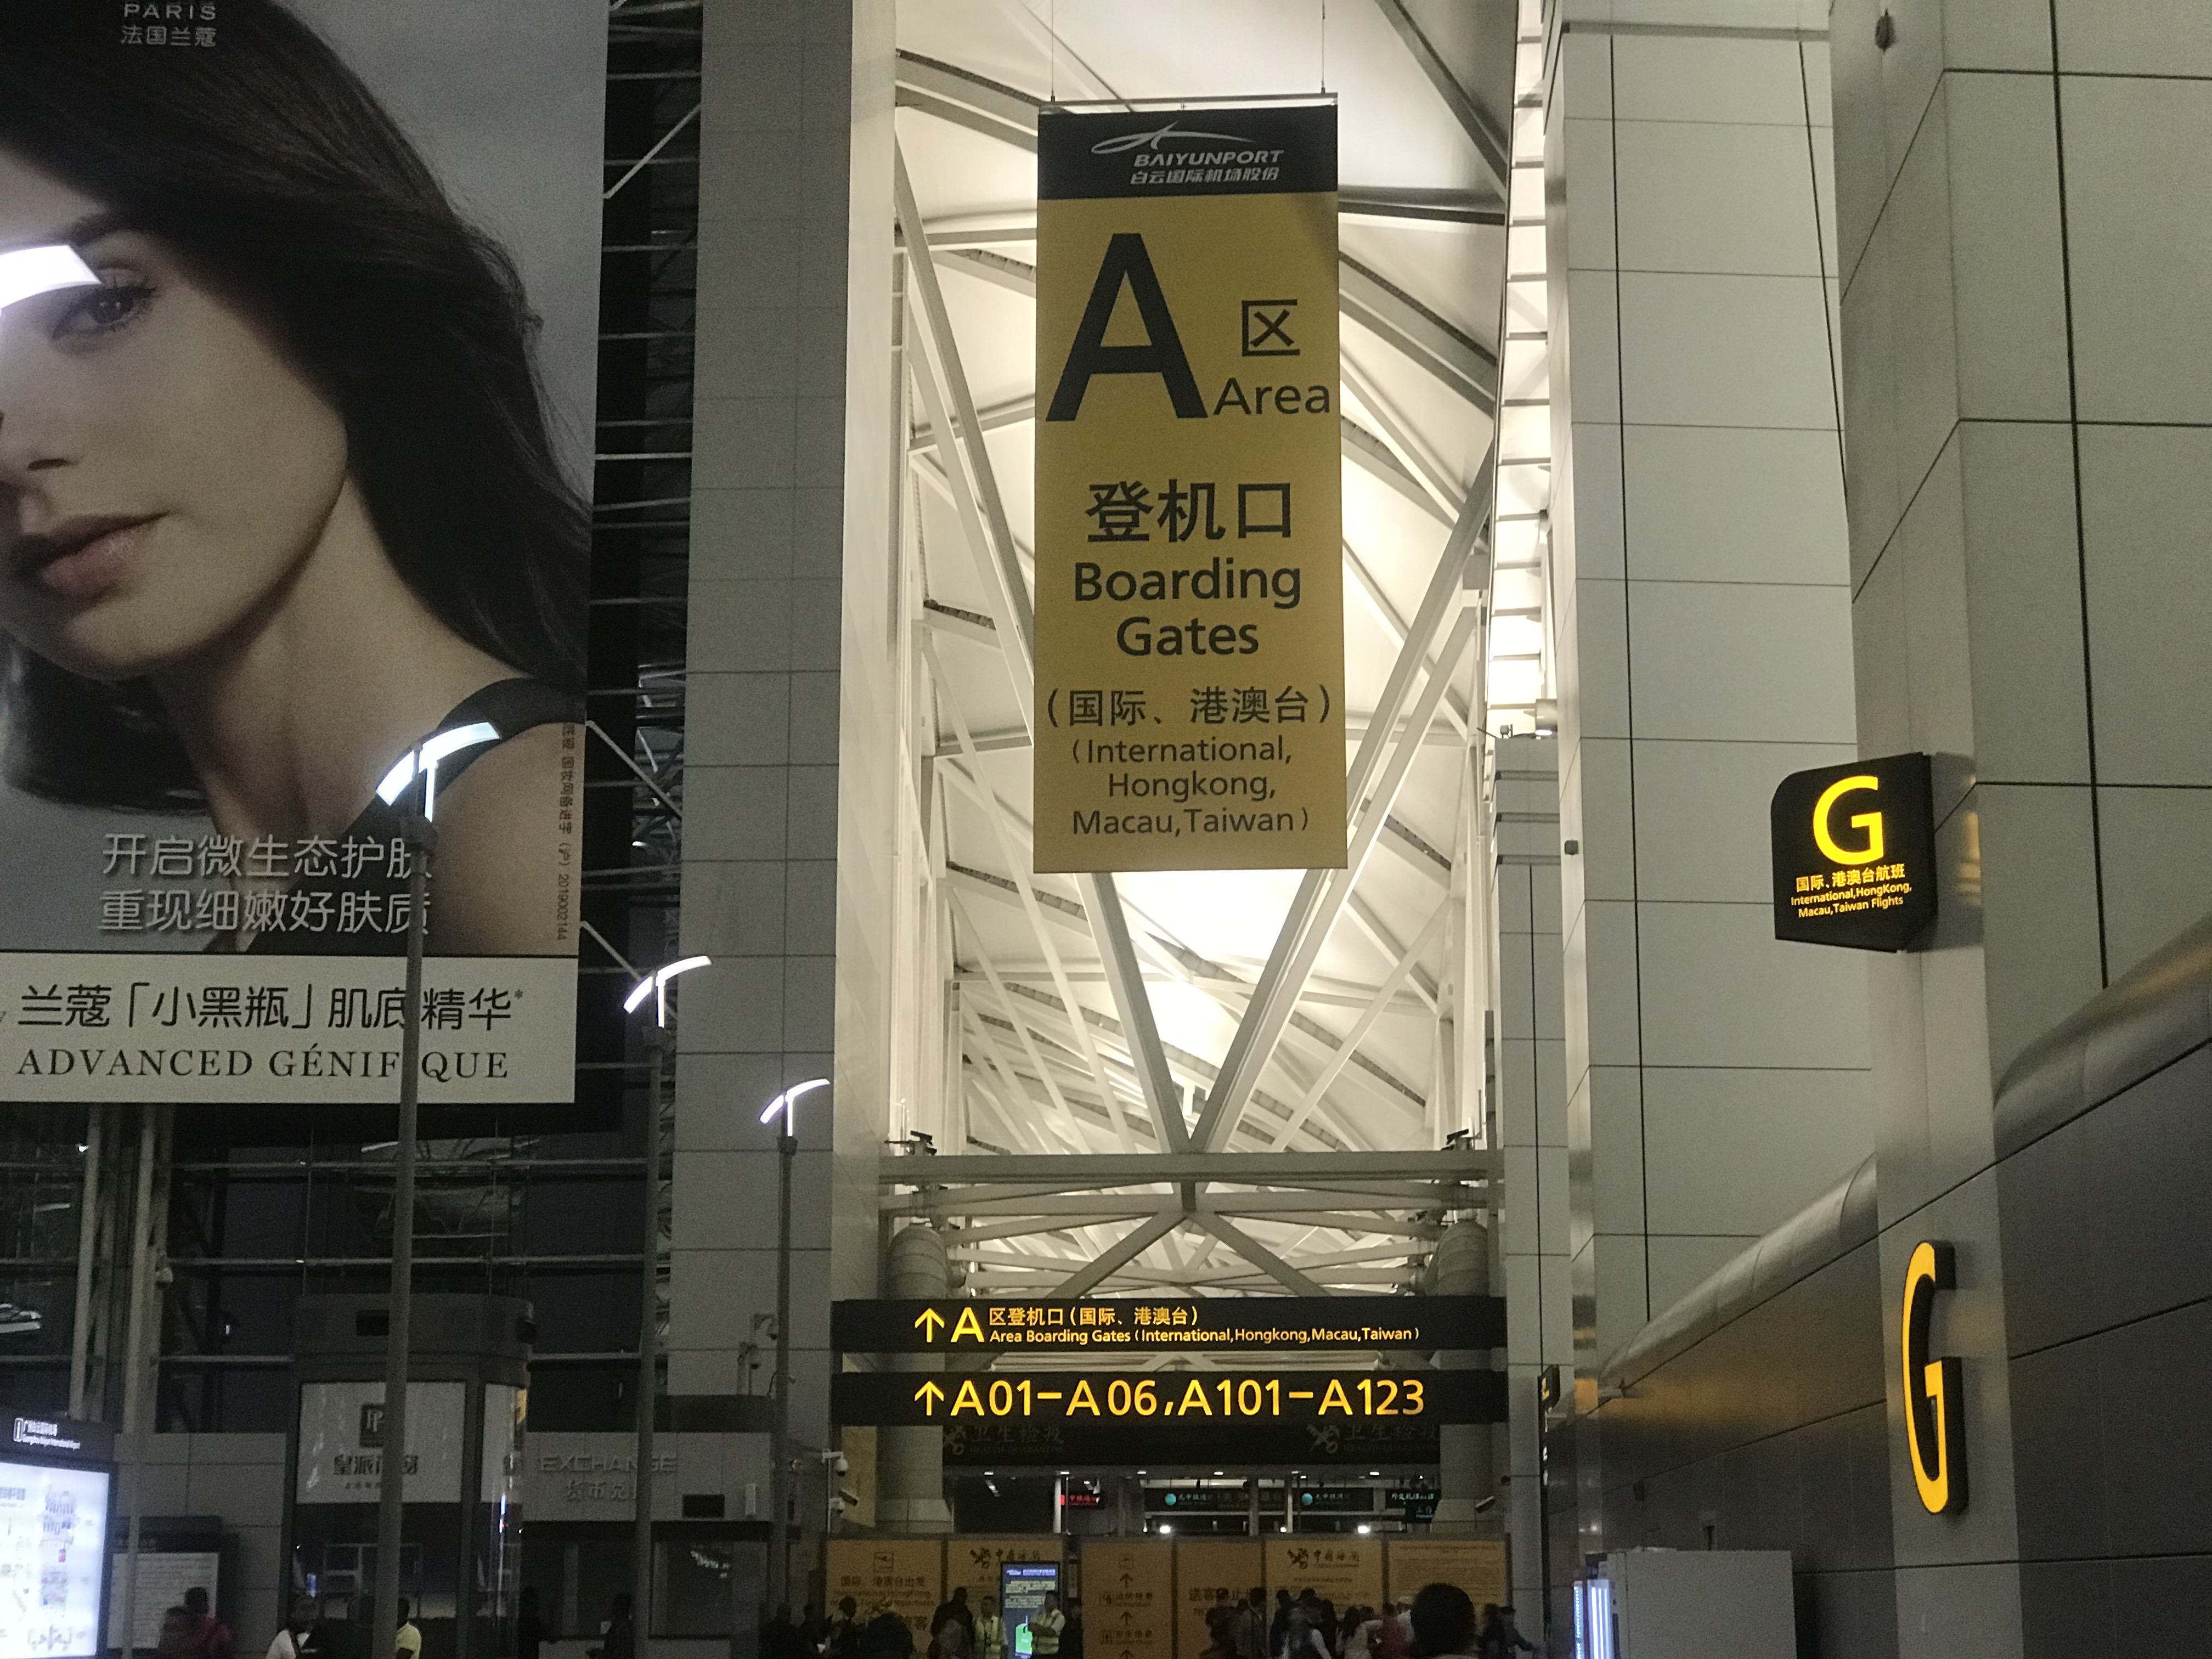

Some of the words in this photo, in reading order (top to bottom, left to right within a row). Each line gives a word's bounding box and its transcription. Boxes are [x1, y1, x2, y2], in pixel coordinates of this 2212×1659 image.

[123, 3, 216, 20] PARIS
[120, 25, 217, 47] 法国兰蔻
[1130, 167, 1279, 184] 白云国际机场股份
[1134, 150, 1284, 167] BAIYUNPORT
[1045, 233, 1208, 421] A
[1242, 299, 1300, 357] 区
[1212, 377, 1330, 415] Area
[1085, 478, 1291, 543] 登机口
[1075, 557, 1301, 609] Boarding
[1116, 616, 1259, 656] Gates
[1073, 735, 1291, 764] (International,
[1108, 770, 1276, 803] Hongkong,
[1813, 775, 1884, 865] G
[1796, 864, 1905, 893] 国际、港澳台航班
[98, 888, 431, 934] 重现细嫩好肤质
[1871, 895, 1904, 909] Flights
[17, 1048, 253, 1077] ADVANCED
[269, 1043, 509, 1083] GÉNIFQUE
[950, 1306, 985, 1342] A
[990, 1330, 1022, 1342] Area
[1026, 1329, 1088, 1345] Boarding
[1092, 1329, 1131, 1342] Gates
[1901, 1242, 1951, 1514] G
[566, 1480, 638, 1501] 货币兑
